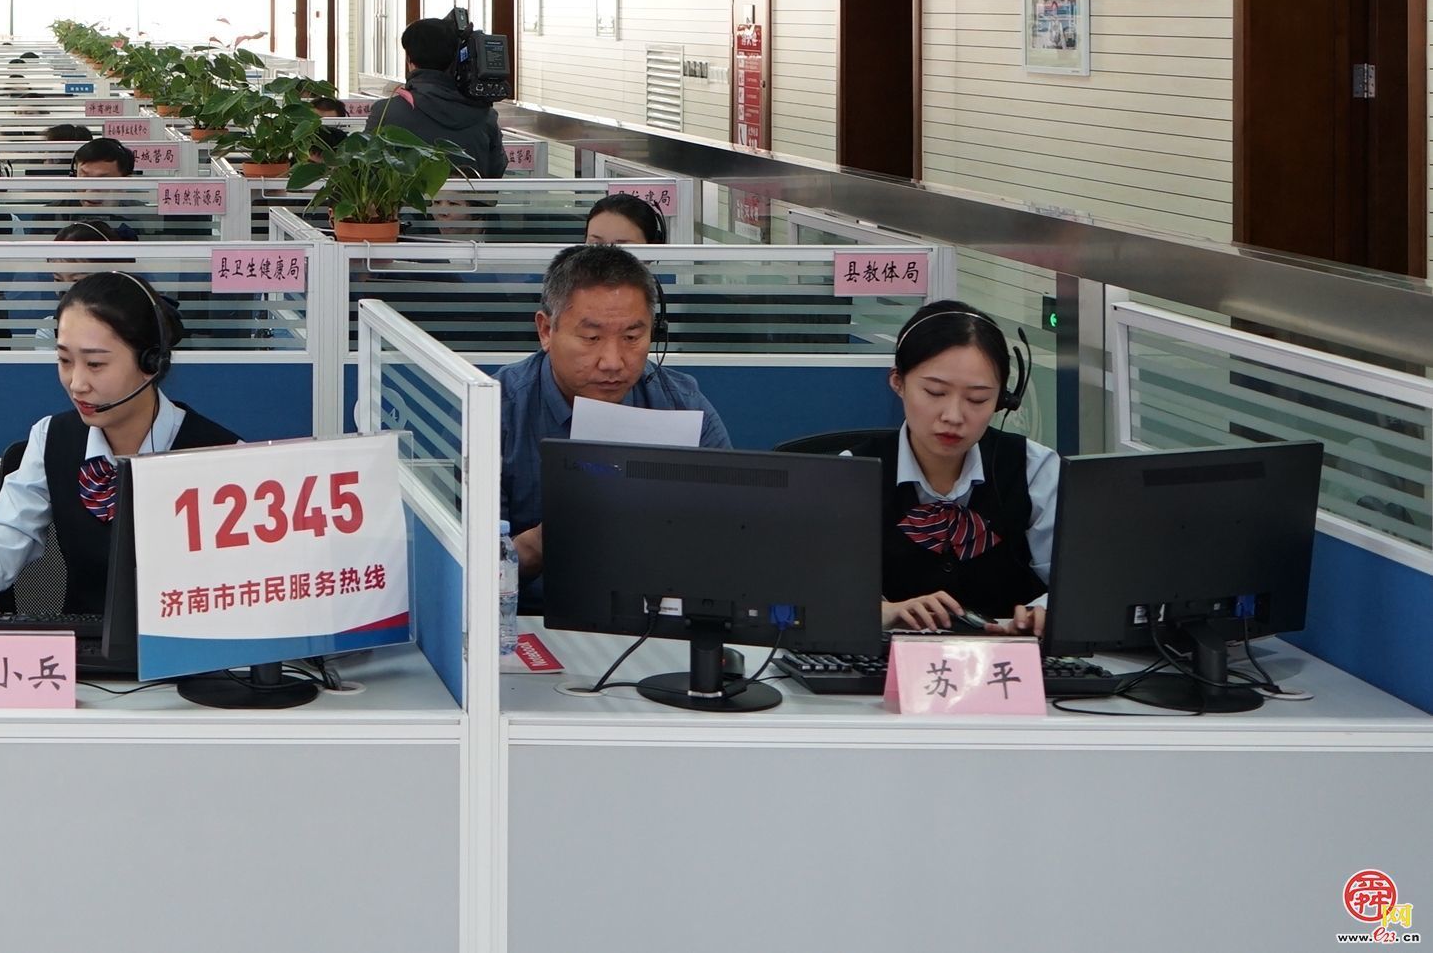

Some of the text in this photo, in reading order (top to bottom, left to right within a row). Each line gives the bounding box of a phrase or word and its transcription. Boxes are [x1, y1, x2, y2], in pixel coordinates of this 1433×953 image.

[162, 188, 222, 207] 县自然资源局
[218, 255, 300, 281] 县卫生健康局
[844, 260, 920, 284] 县教体局
[174, 470, 364, 552] 12345
[159, 563, 387, 618] 济南市市民服务热线
[923, 659, 1022, 700] 苏平
